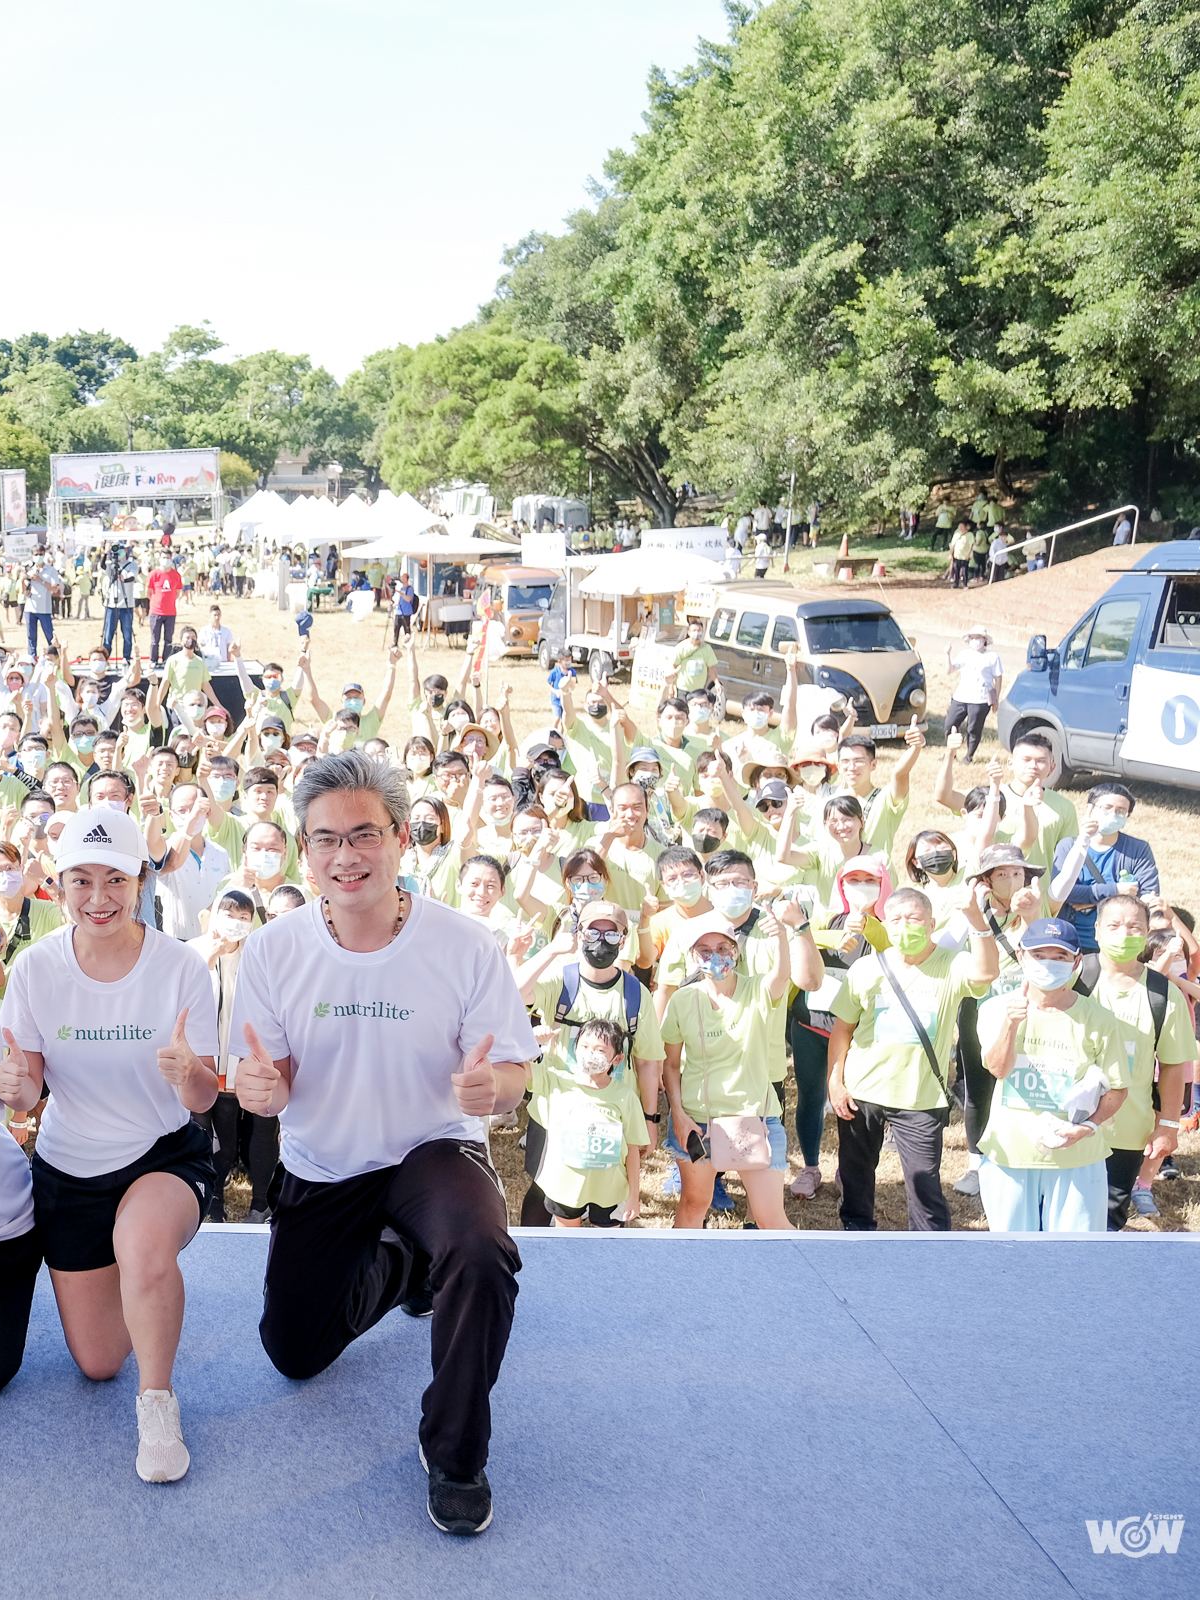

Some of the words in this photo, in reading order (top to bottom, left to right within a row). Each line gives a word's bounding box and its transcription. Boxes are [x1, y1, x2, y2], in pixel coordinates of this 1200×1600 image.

[83, 835, 112, 844] adidas
[333, 1001, 410, 1020] nutrilite
[75, 1025, 153, 1040] nutrilite
